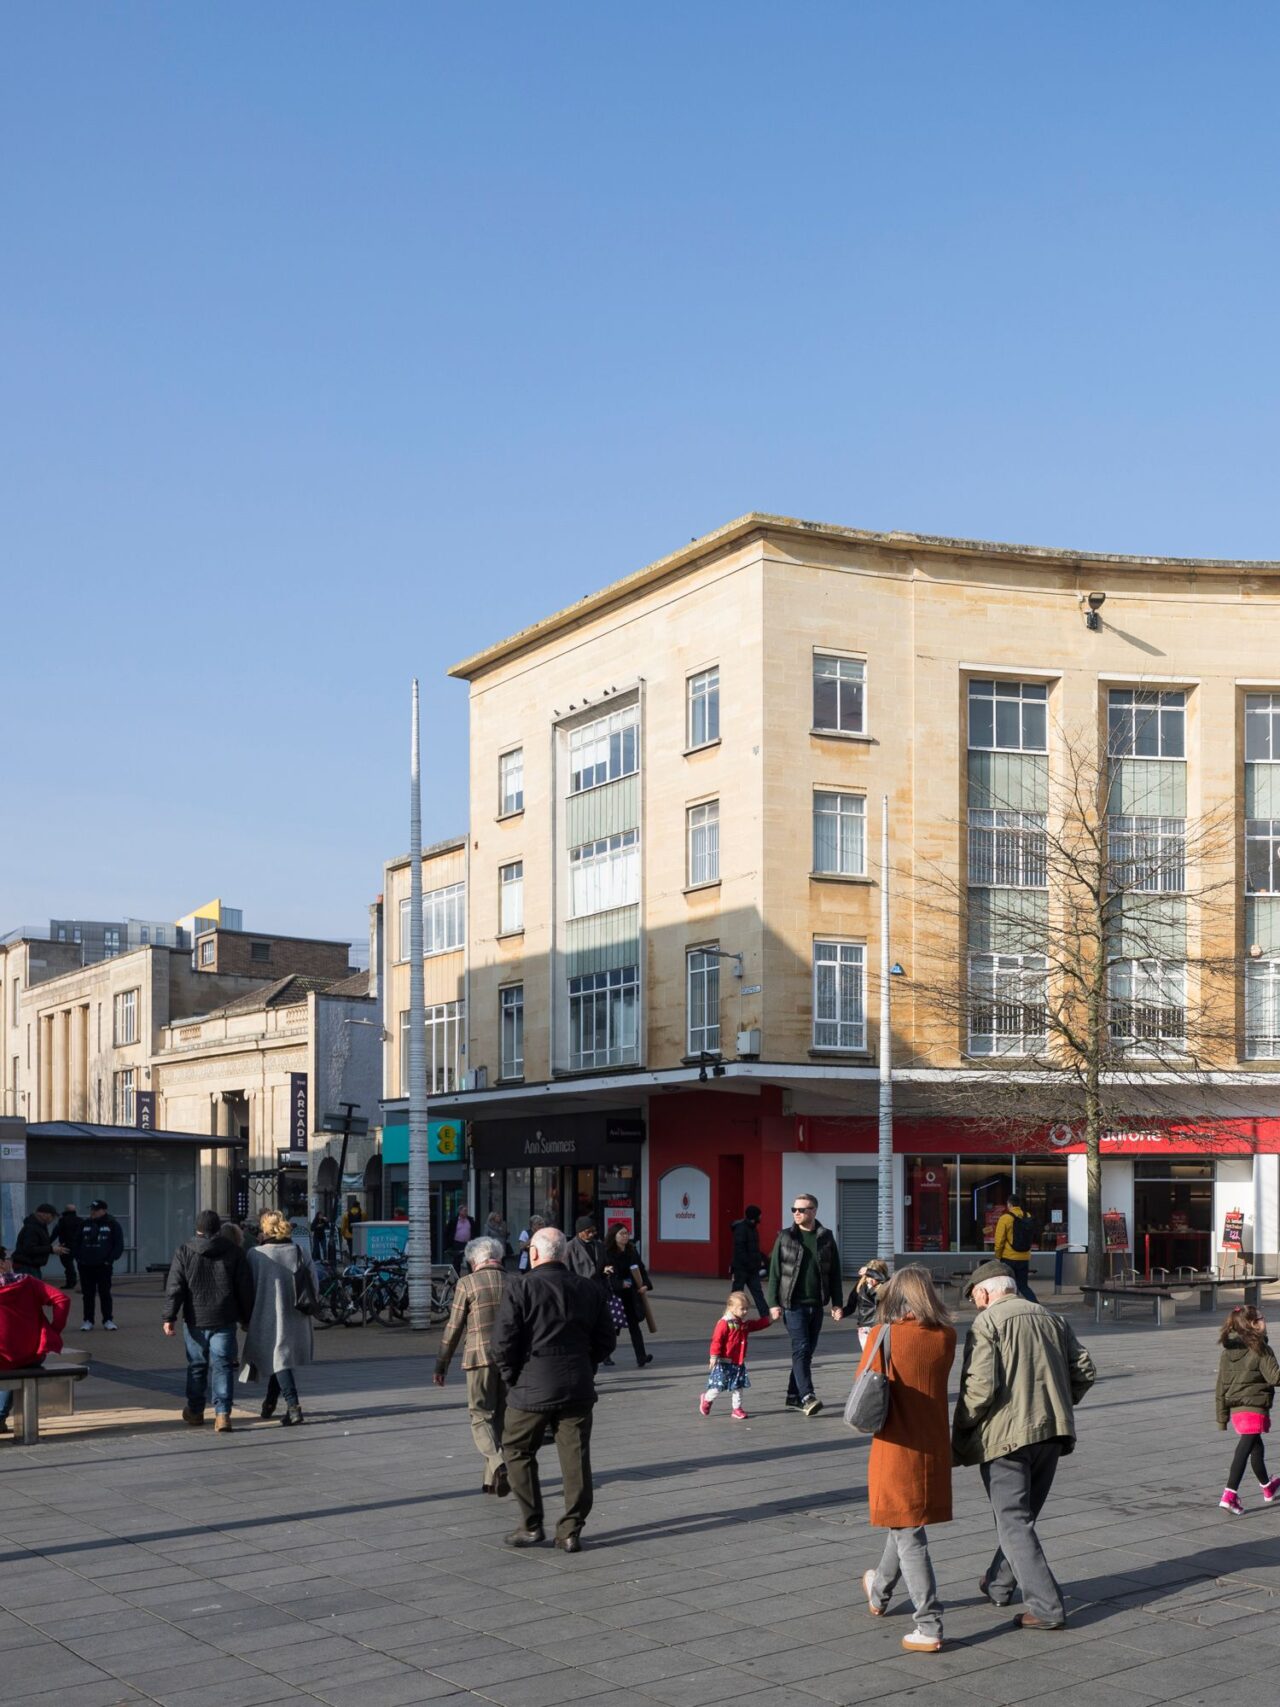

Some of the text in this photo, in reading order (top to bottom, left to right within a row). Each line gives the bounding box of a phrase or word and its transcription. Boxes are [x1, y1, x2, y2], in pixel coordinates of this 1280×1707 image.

[141, 1105, 150, 1129] ARC
[296, 1089, 306, 1147] ARCADE
[524, 1137, 576, 1154] Ann Summers
